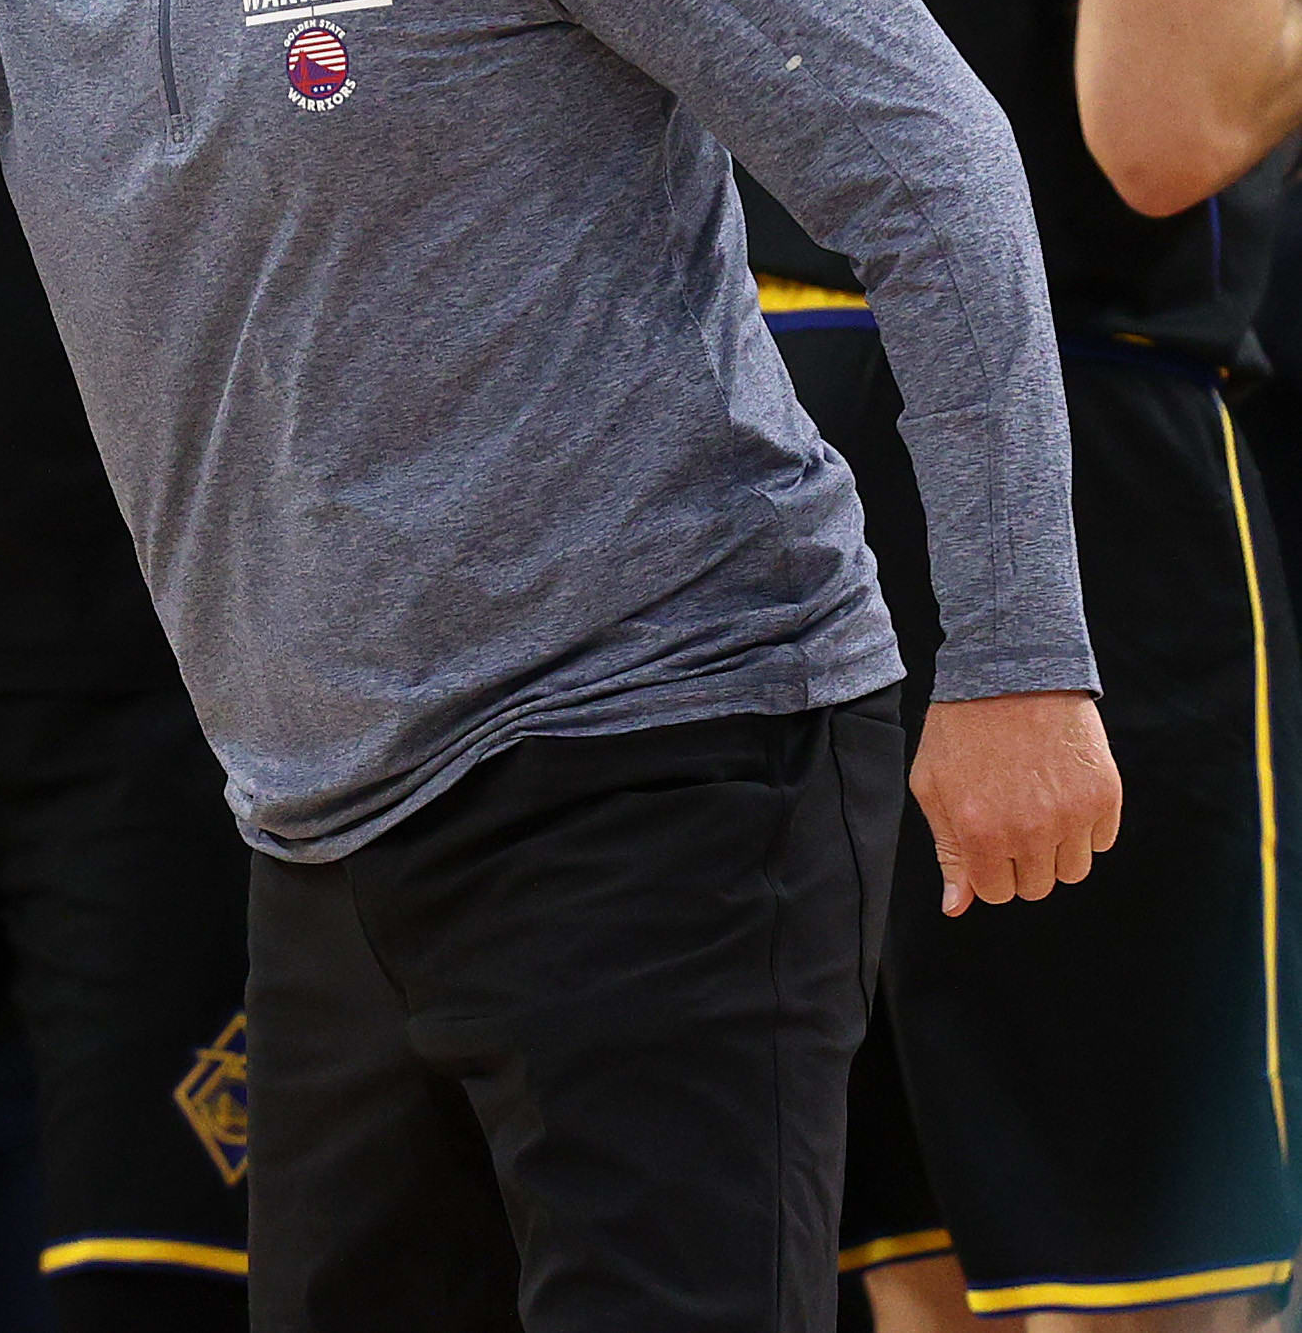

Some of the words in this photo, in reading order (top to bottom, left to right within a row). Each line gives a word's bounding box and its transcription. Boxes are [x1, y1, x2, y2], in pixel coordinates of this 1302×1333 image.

[283, 18, 317, 48] GOLDEN
[318, 18, 348, 39] STATE
[287, 77, 357, 112] WARRIORS
